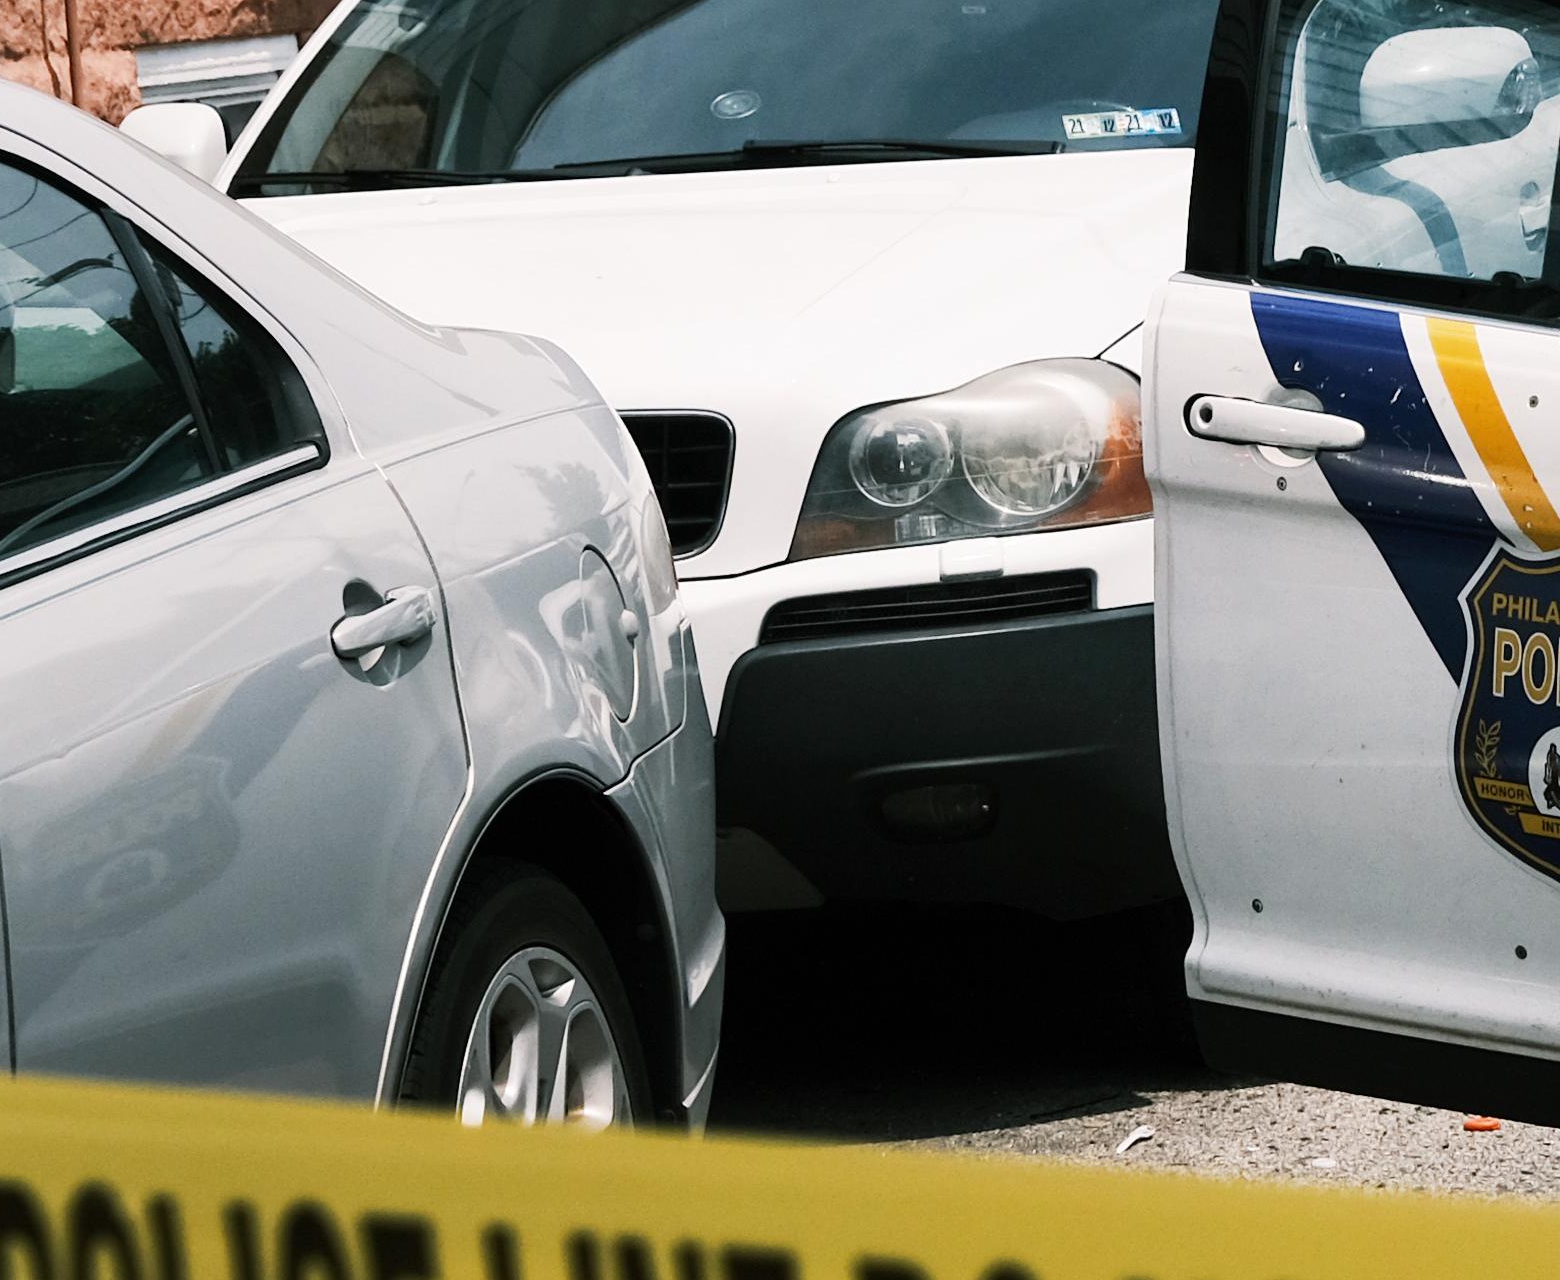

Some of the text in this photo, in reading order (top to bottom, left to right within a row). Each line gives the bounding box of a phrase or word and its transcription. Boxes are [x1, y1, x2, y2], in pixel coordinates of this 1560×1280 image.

[1068, 119, 1086, 134] 21
[1127, 115, 1143, 130] 21
[1159, 112, 1175, 129] 12
[1481, 783, 1525, 800] HONOR
